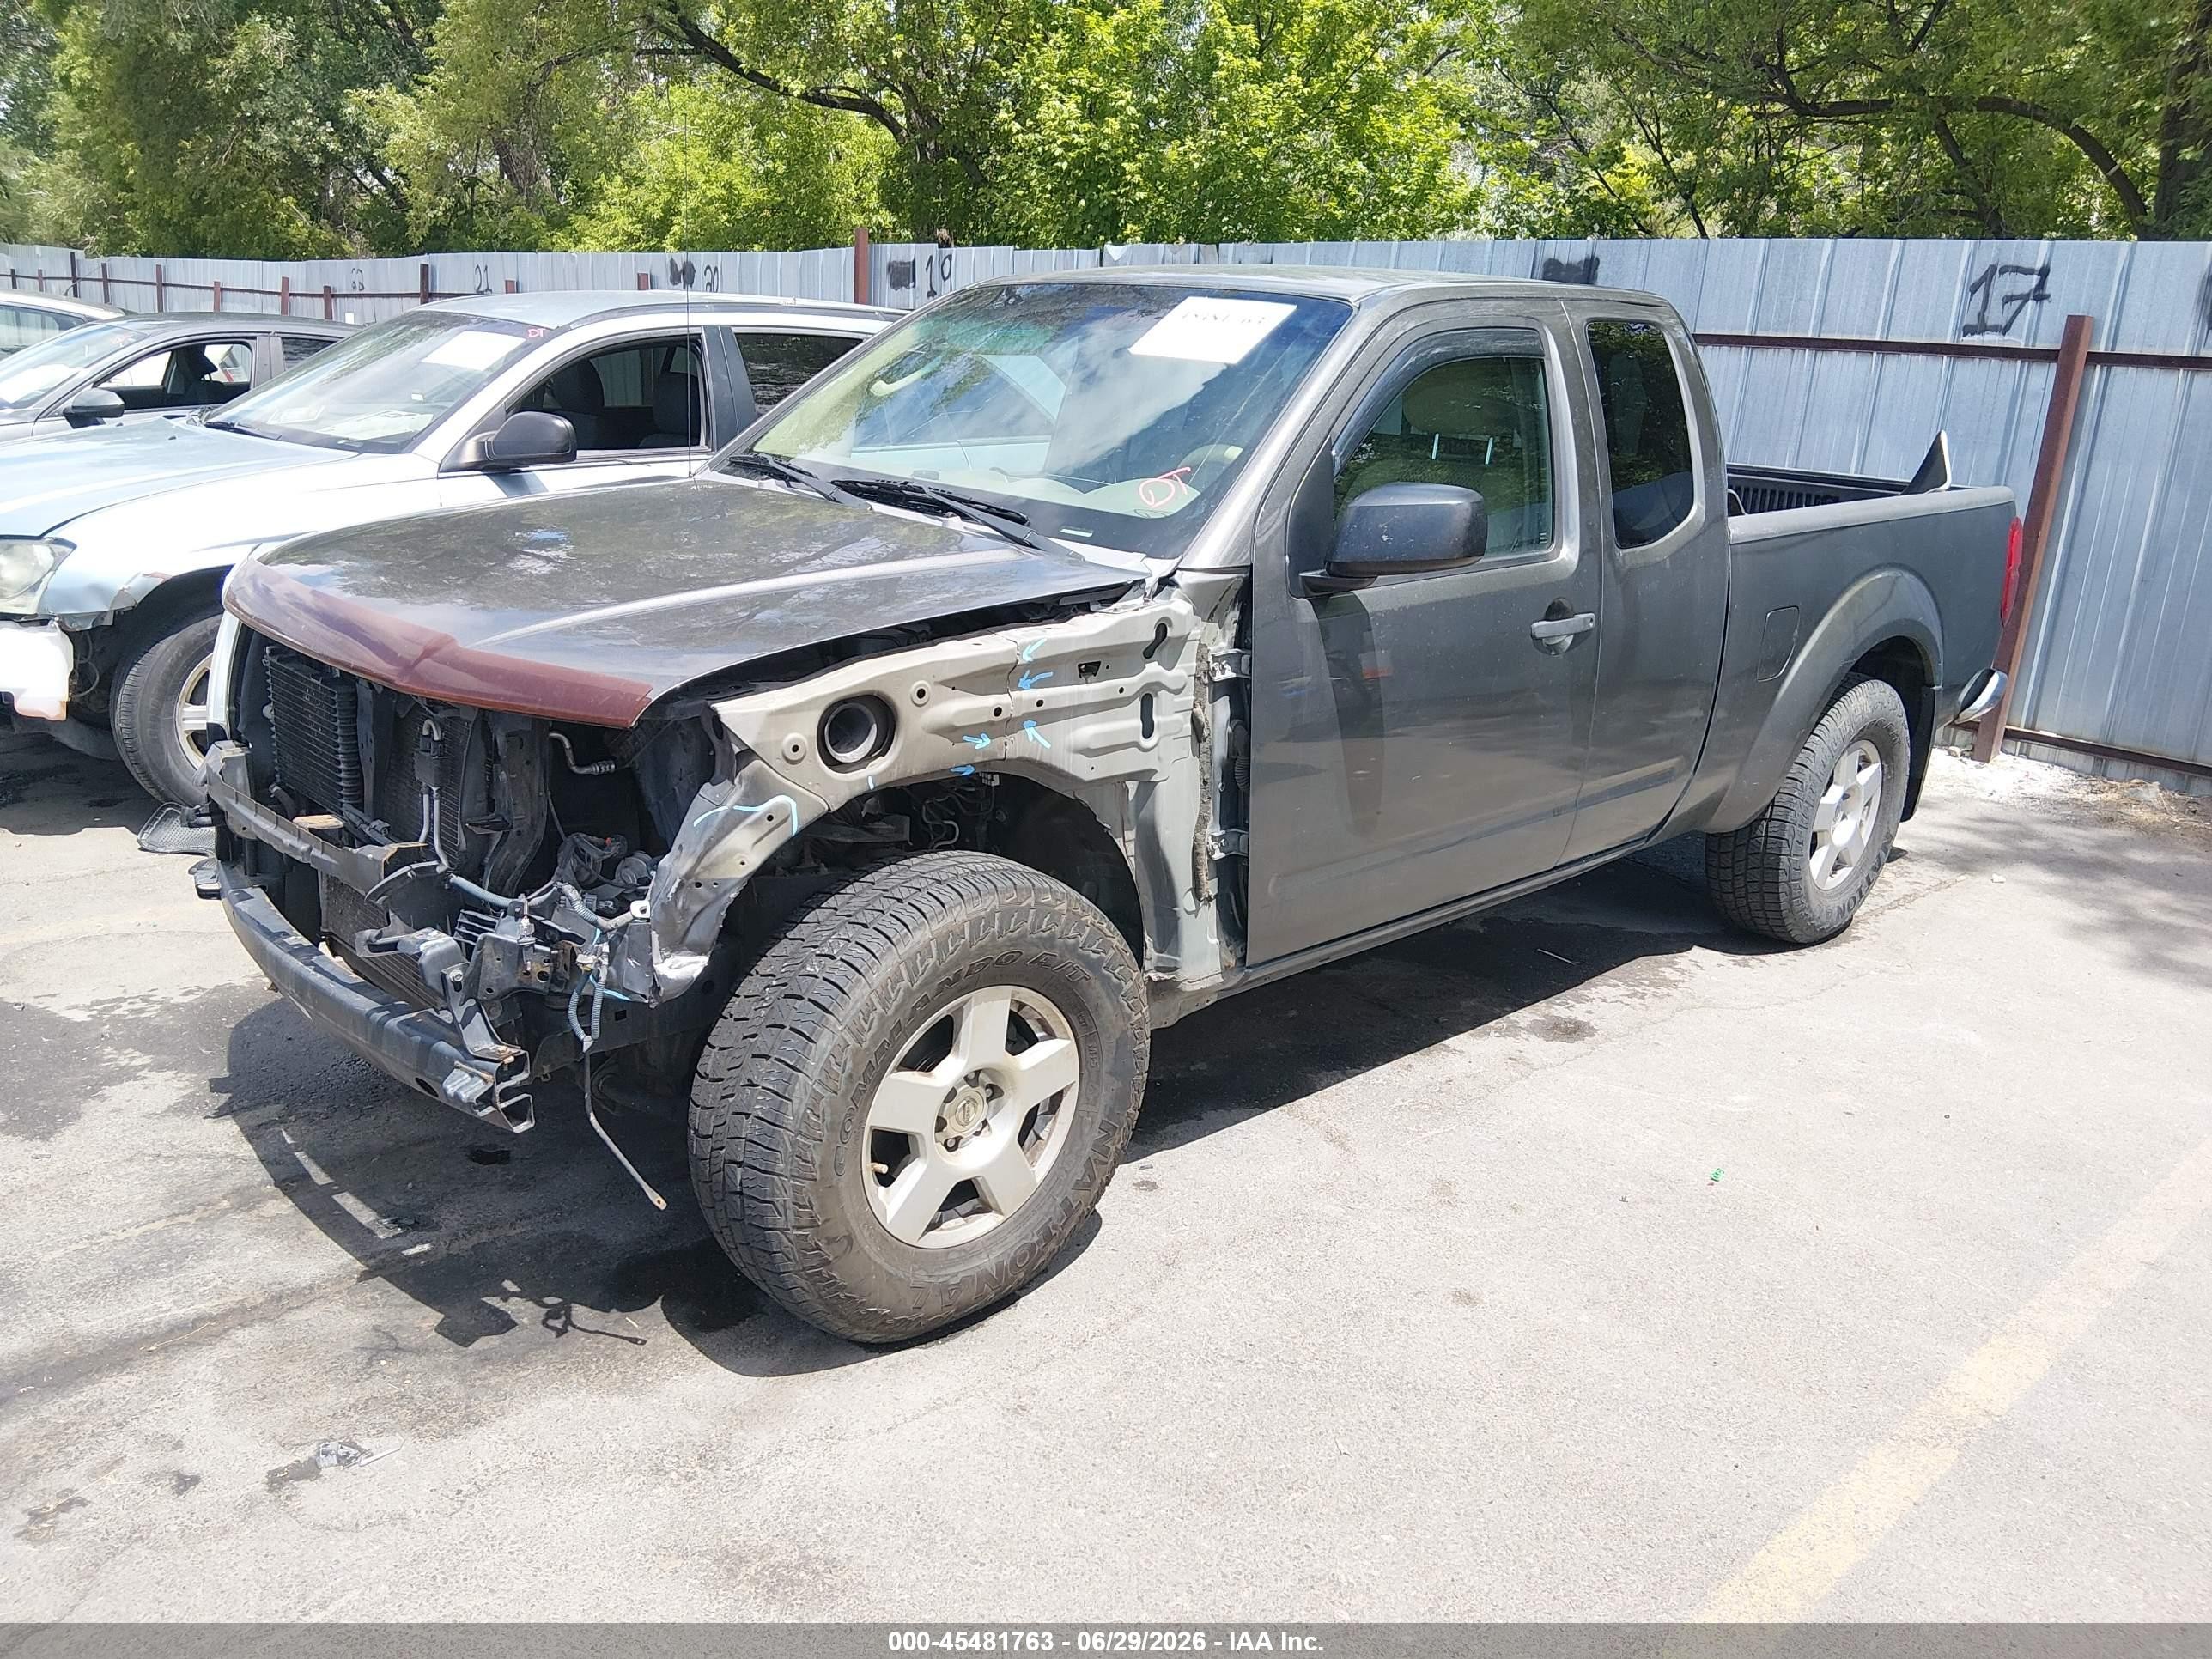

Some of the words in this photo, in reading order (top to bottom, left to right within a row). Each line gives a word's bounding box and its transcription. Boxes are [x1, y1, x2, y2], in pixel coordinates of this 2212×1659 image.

[474, 264, 493, 294] 21
[925, 253, 953, 298] 19
[1962, 264, 2051, 337] 17
[527, 328, 546, 337] DT
[834, 950, 1024, 1176] COMMANDO
[909, 1118, 1120, 1310] NATIONAL
